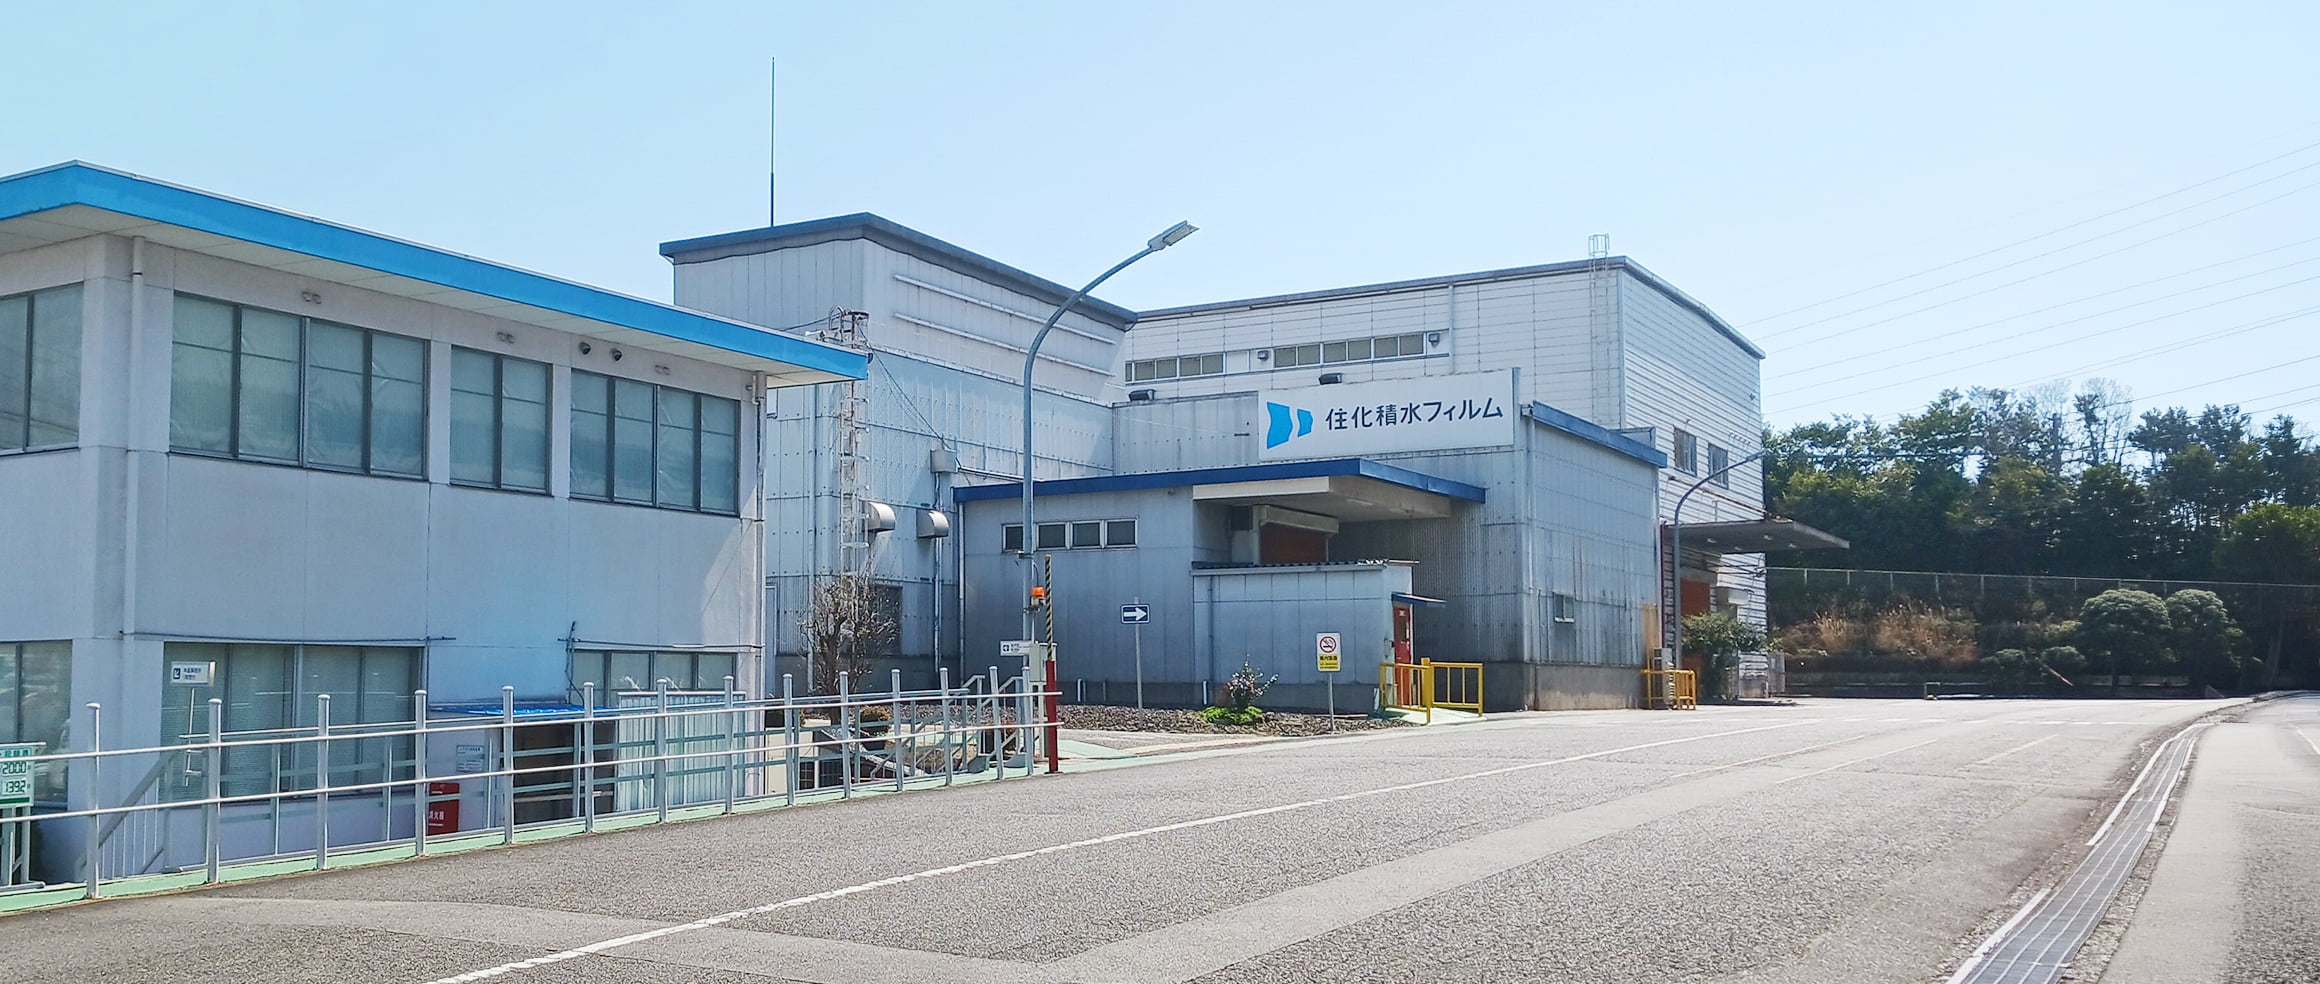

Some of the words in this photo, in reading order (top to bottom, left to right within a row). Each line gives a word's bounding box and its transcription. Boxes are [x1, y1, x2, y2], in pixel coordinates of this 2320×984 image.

[1325, 397, 1504, 431] 住化積水フィルム
